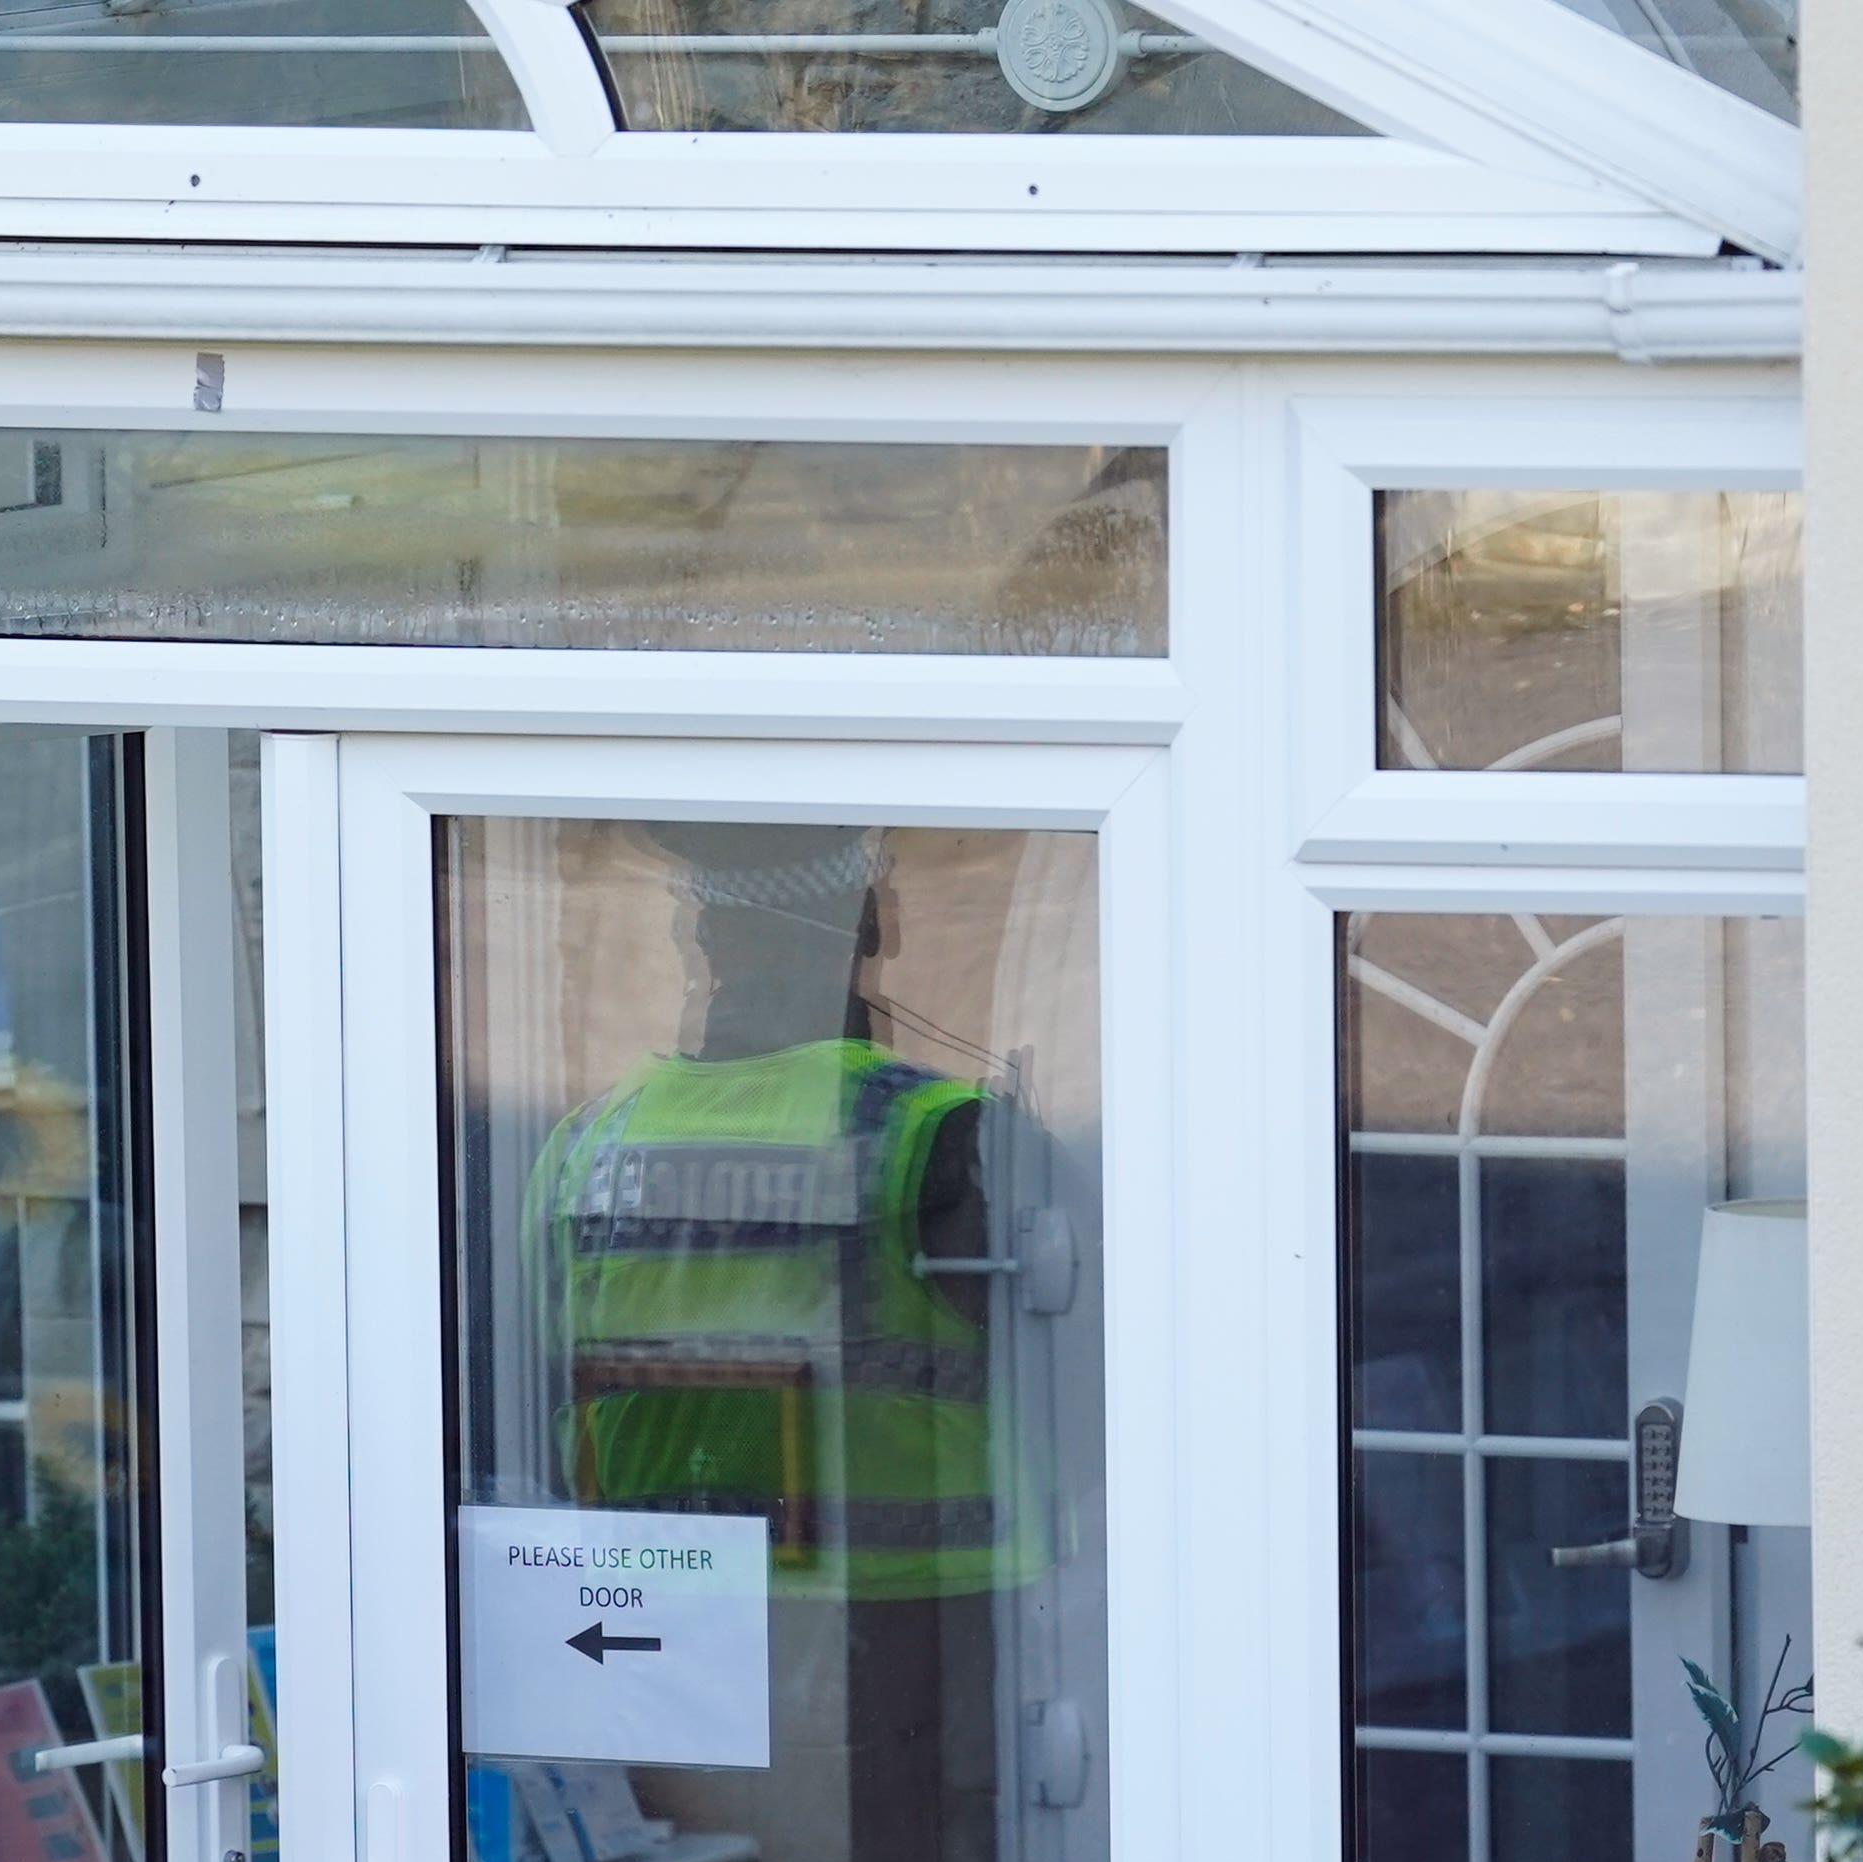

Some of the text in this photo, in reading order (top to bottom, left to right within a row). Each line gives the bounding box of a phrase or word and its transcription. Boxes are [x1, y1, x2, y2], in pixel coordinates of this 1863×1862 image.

[507, 1545, 714, 1571] PLEASE USE OTHER
[579, 1586, 644, 1609] DOOR
